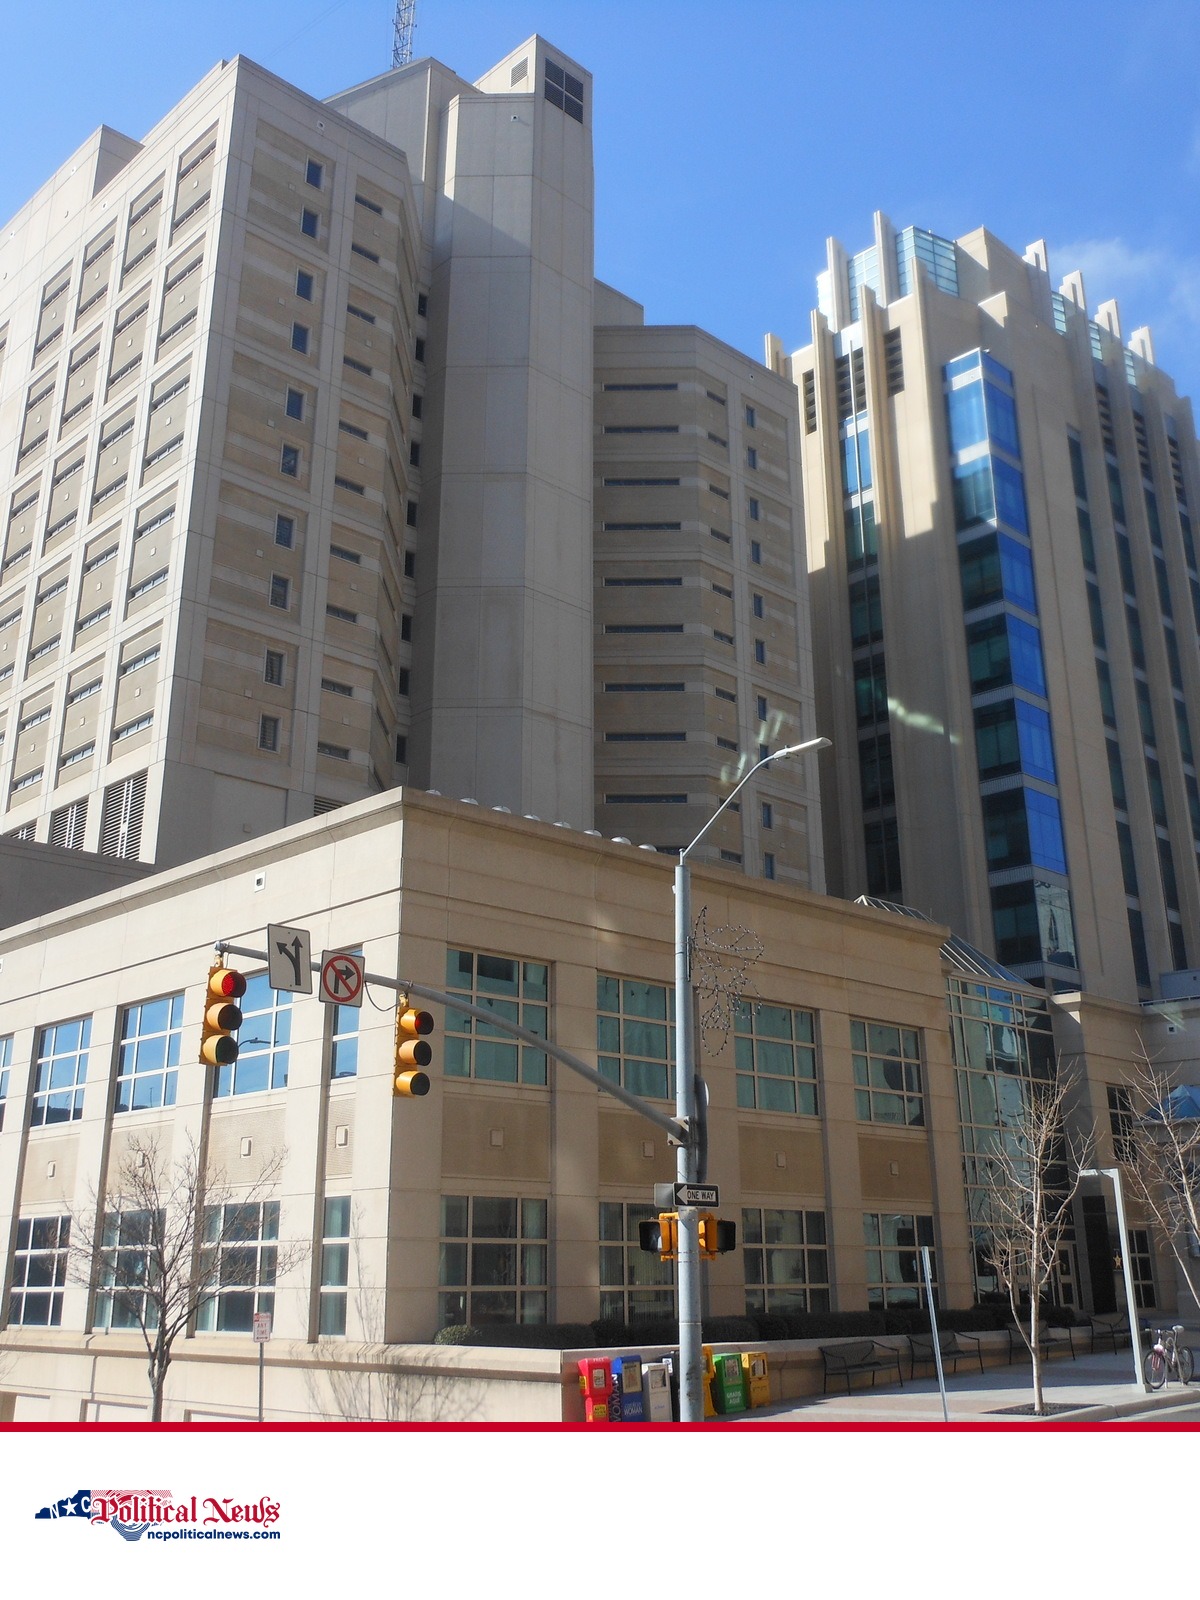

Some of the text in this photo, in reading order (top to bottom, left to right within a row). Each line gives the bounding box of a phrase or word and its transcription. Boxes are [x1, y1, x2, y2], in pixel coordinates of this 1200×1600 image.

[687, 1190, 715, 1200] ONE WAY
[624, 1407, 643, 1416] WOMAN
